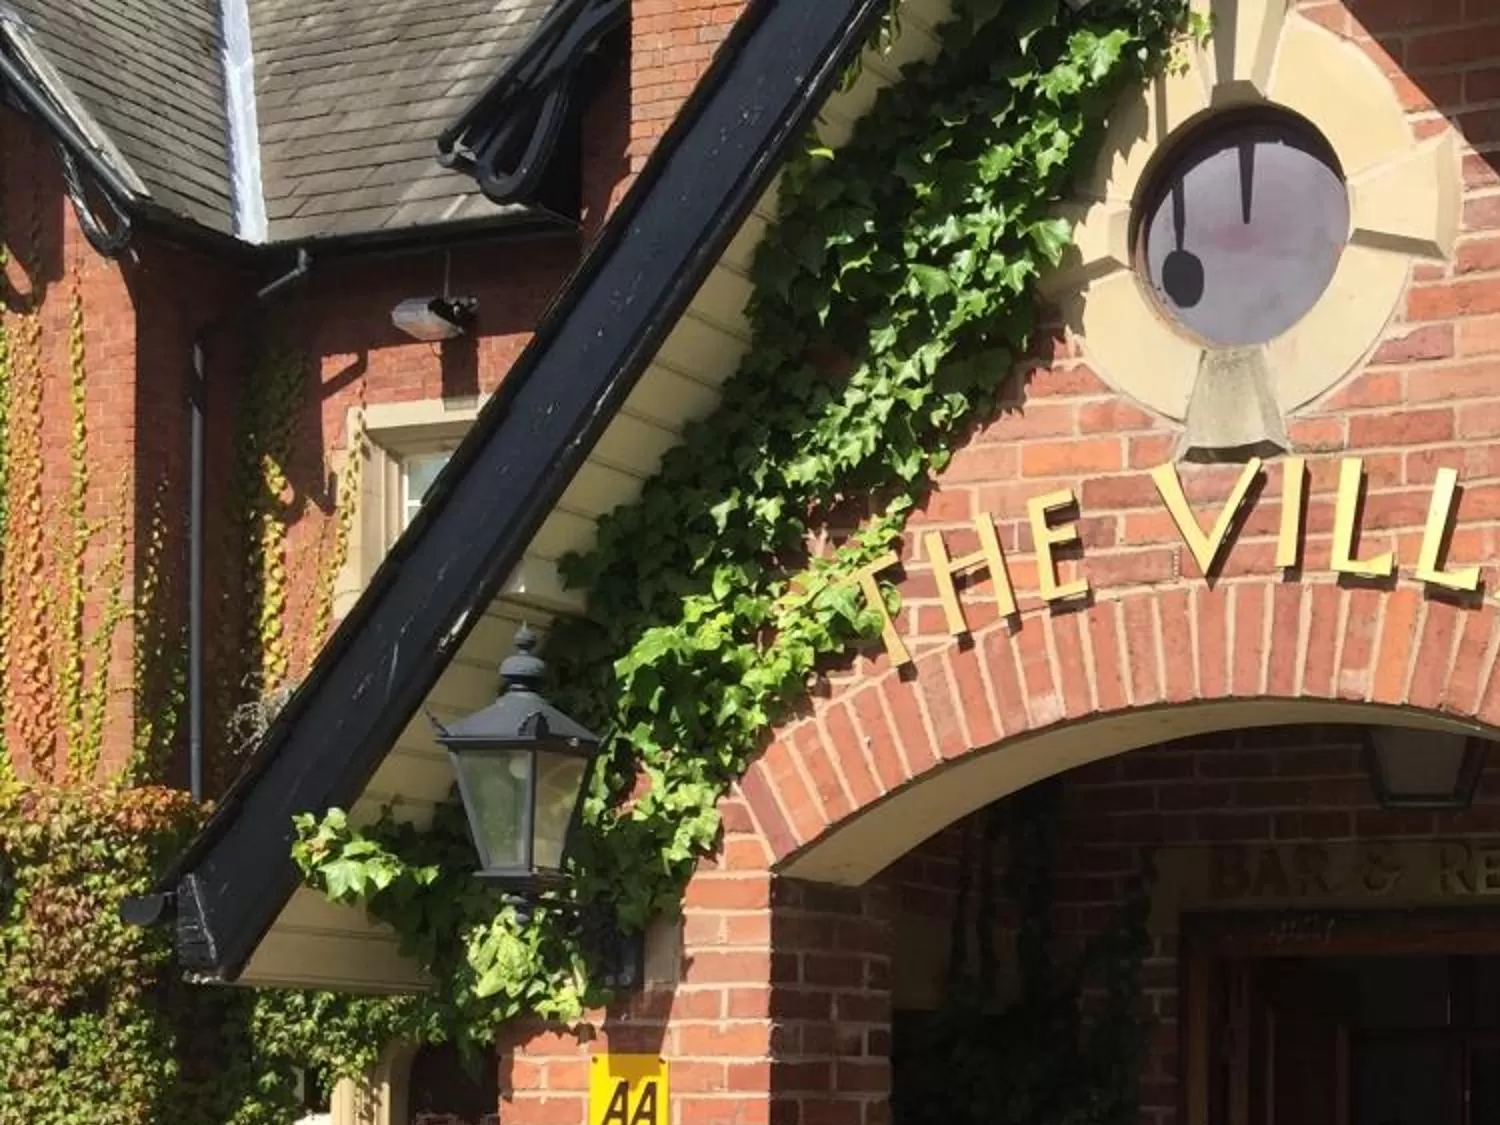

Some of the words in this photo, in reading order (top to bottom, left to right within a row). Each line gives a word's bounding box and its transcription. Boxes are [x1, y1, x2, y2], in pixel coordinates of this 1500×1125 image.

[831, 488, 1090, 668] THE
[1210, 844, 1331, 897] BAR
[1360, 846, 1403, 896] &
